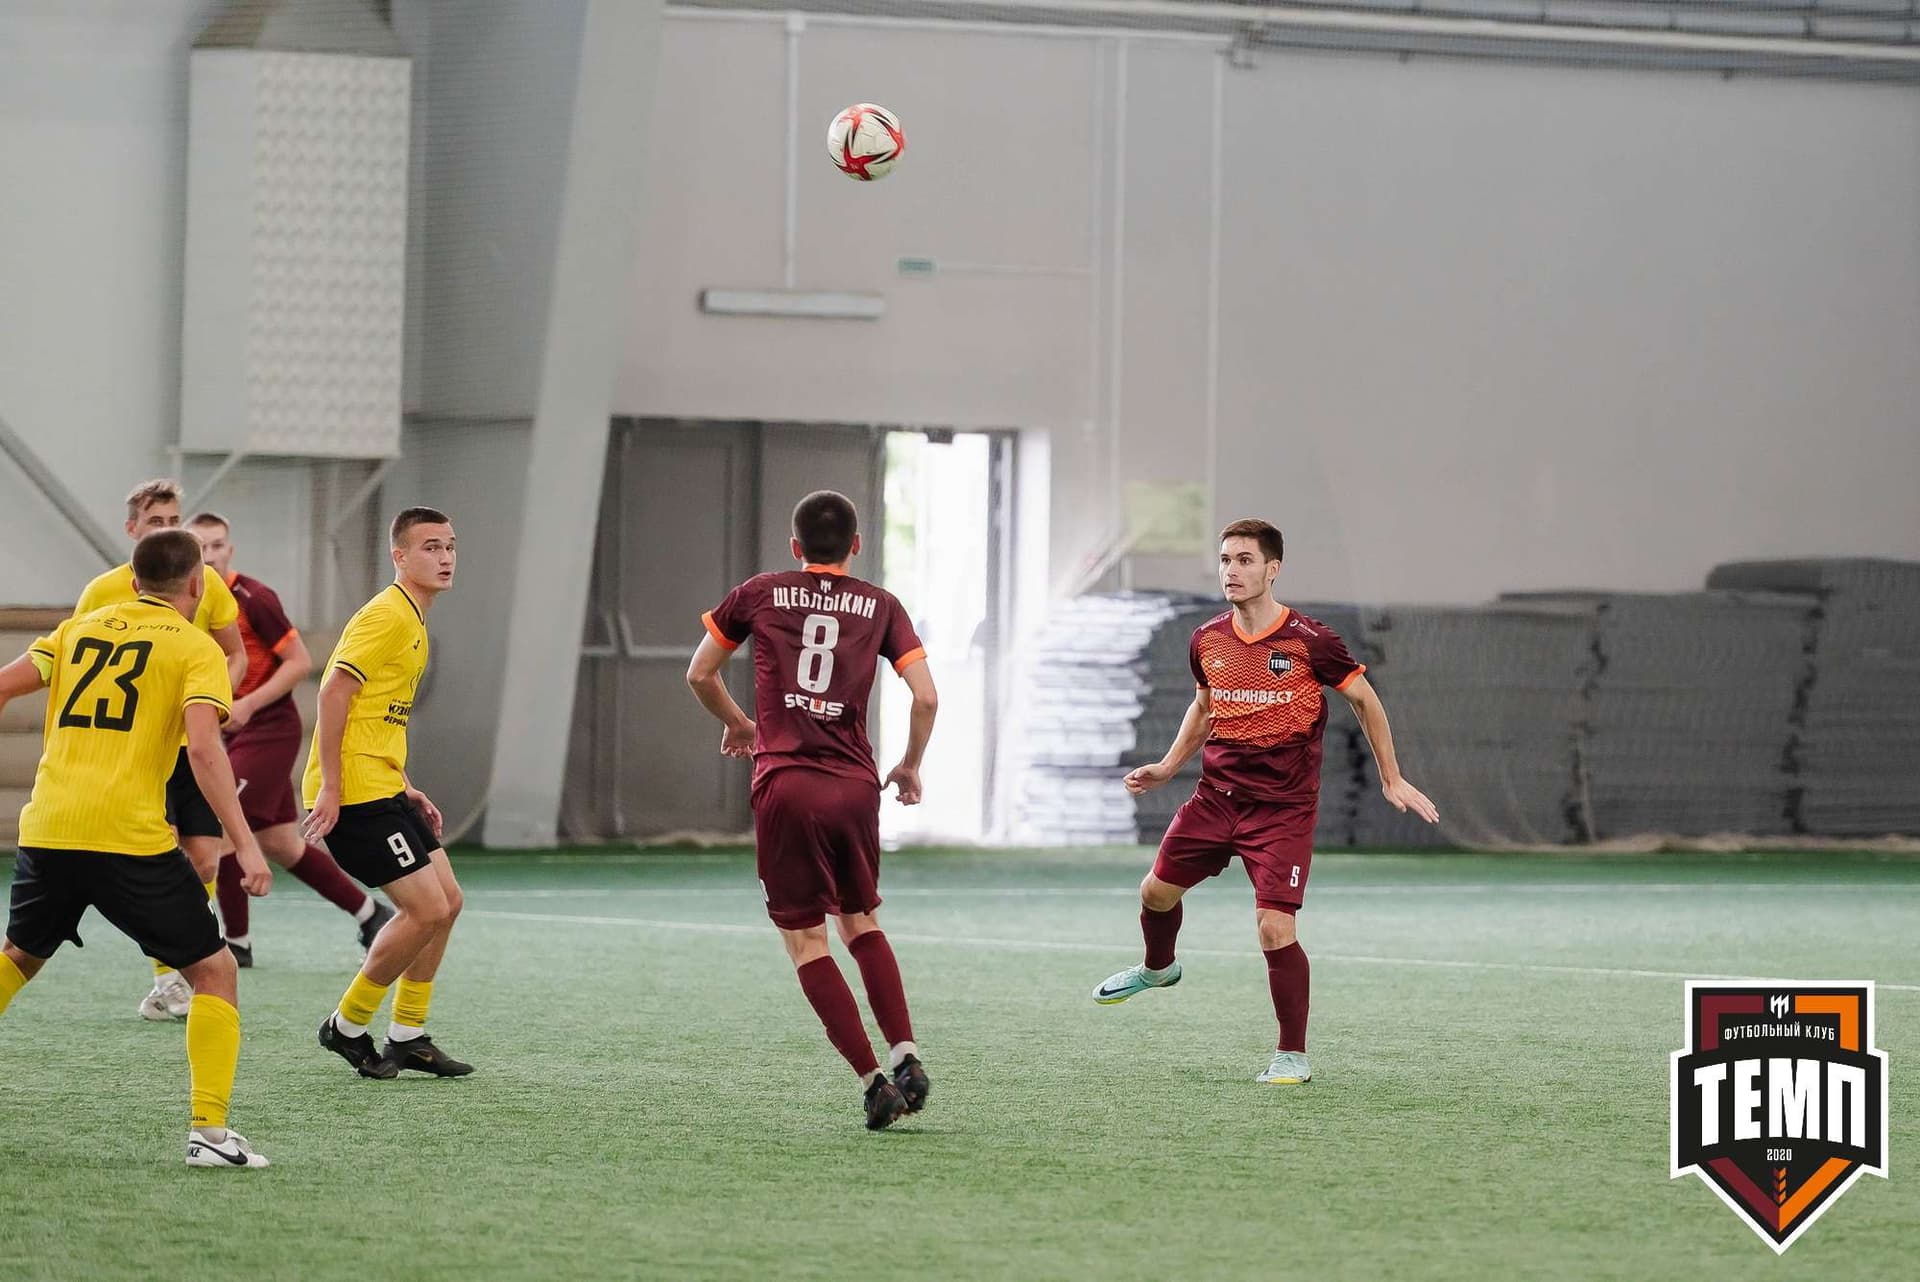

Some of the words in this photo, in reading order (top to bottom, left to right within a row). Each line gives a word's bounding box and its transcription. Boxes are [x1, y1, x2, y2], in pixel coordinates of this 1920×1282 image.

[773, 587, 877, 619] ЩЕБЛЫКИН
[796, 613, 840, 694] 8
[1270, 659, 1291, 671] ТЕМП
[58, 637, 153, 732] 23
[387, 832, 416, 868] 9
[1289, 865, 1301, 887] 5
